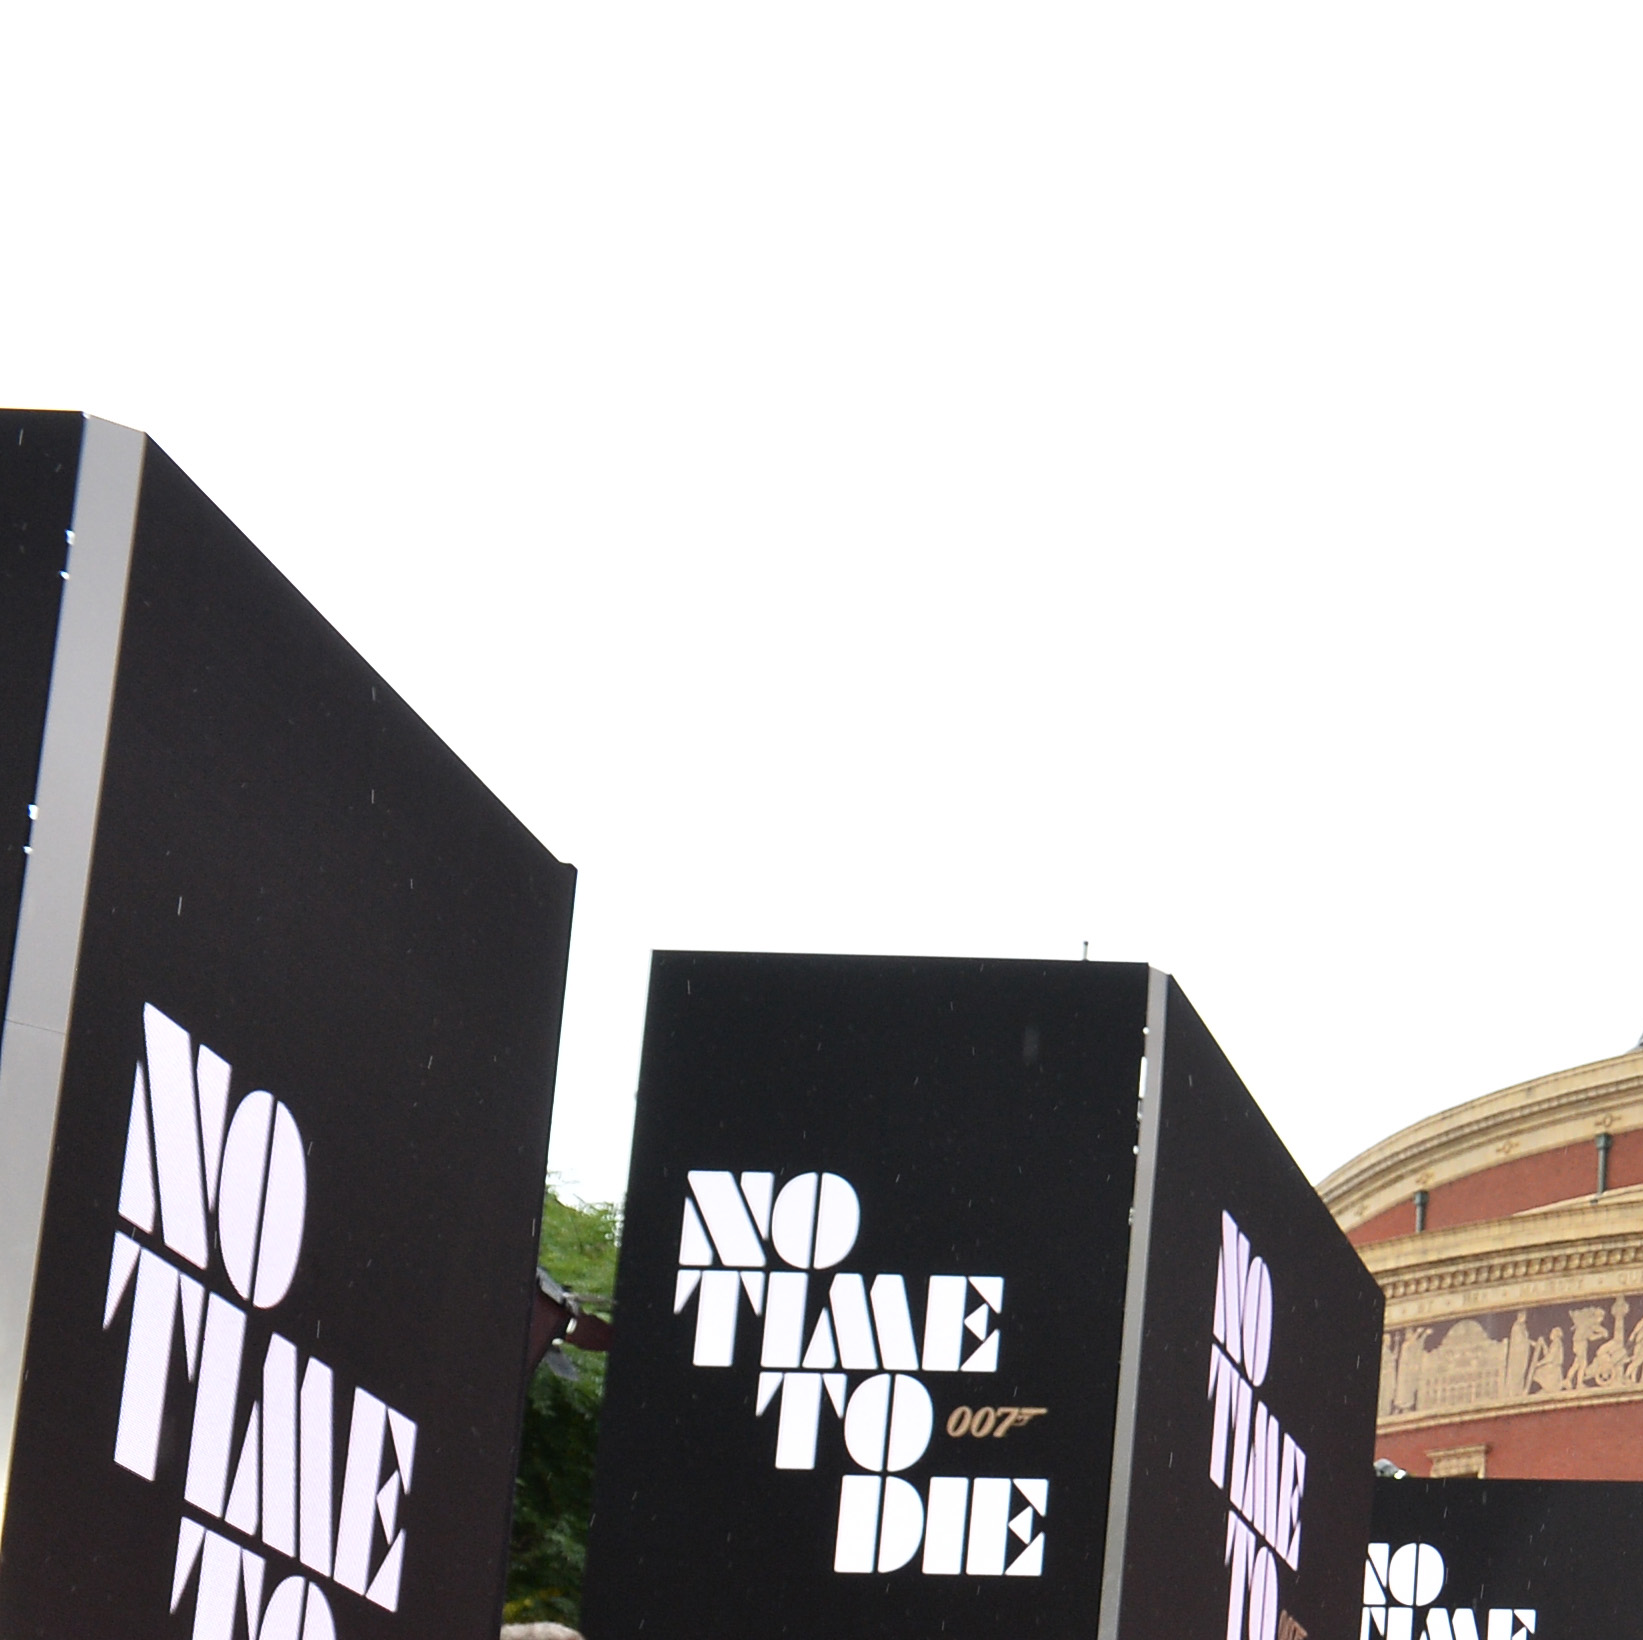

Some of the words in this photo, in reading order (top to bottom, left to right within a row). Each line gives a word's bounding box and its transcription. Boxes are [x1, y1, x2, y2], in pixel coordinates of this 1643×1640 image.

[119, 1003, 306, 1308] NO
[679, 1171, 859, 1269] NO
[674, 1270, 1003, 1372] TIME
[1213, 1210, 1272, 1386] NO
[103, 1232, 416, 1612] TIME
[756, 1372, 932, 1471] TO
[946, 1406, 1047, 1438] 007
[1208, 1344, 1306, 1571] TIME
[834, 1475, 1048, 1576] DIE
